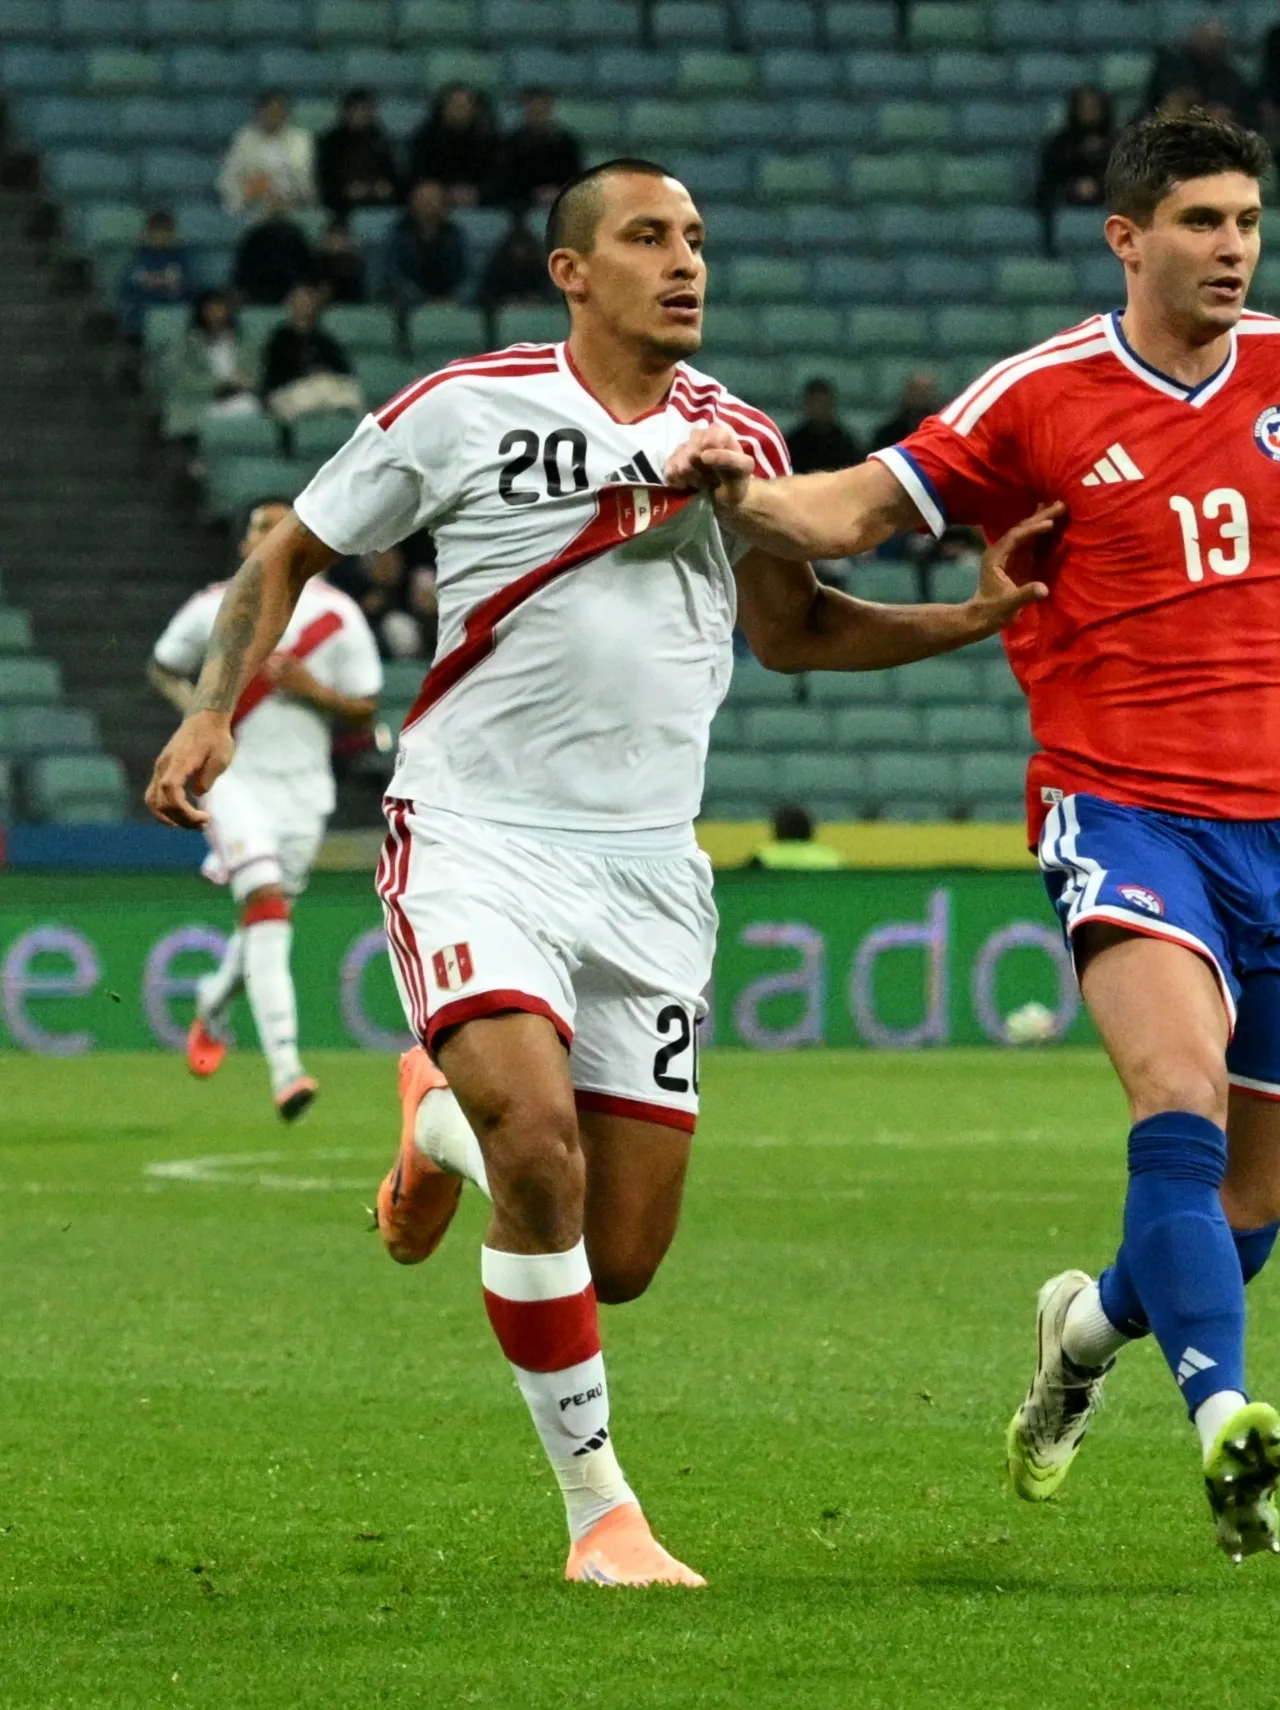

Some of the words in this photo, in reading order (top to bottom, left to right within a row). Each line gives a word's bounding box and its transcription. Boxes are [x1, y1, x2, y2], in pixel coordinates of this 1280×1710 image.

[498, 428, 590, 506] 20
[1169, 487, 1250, 582] 13
[653, 1004, 700, 1095] 2
